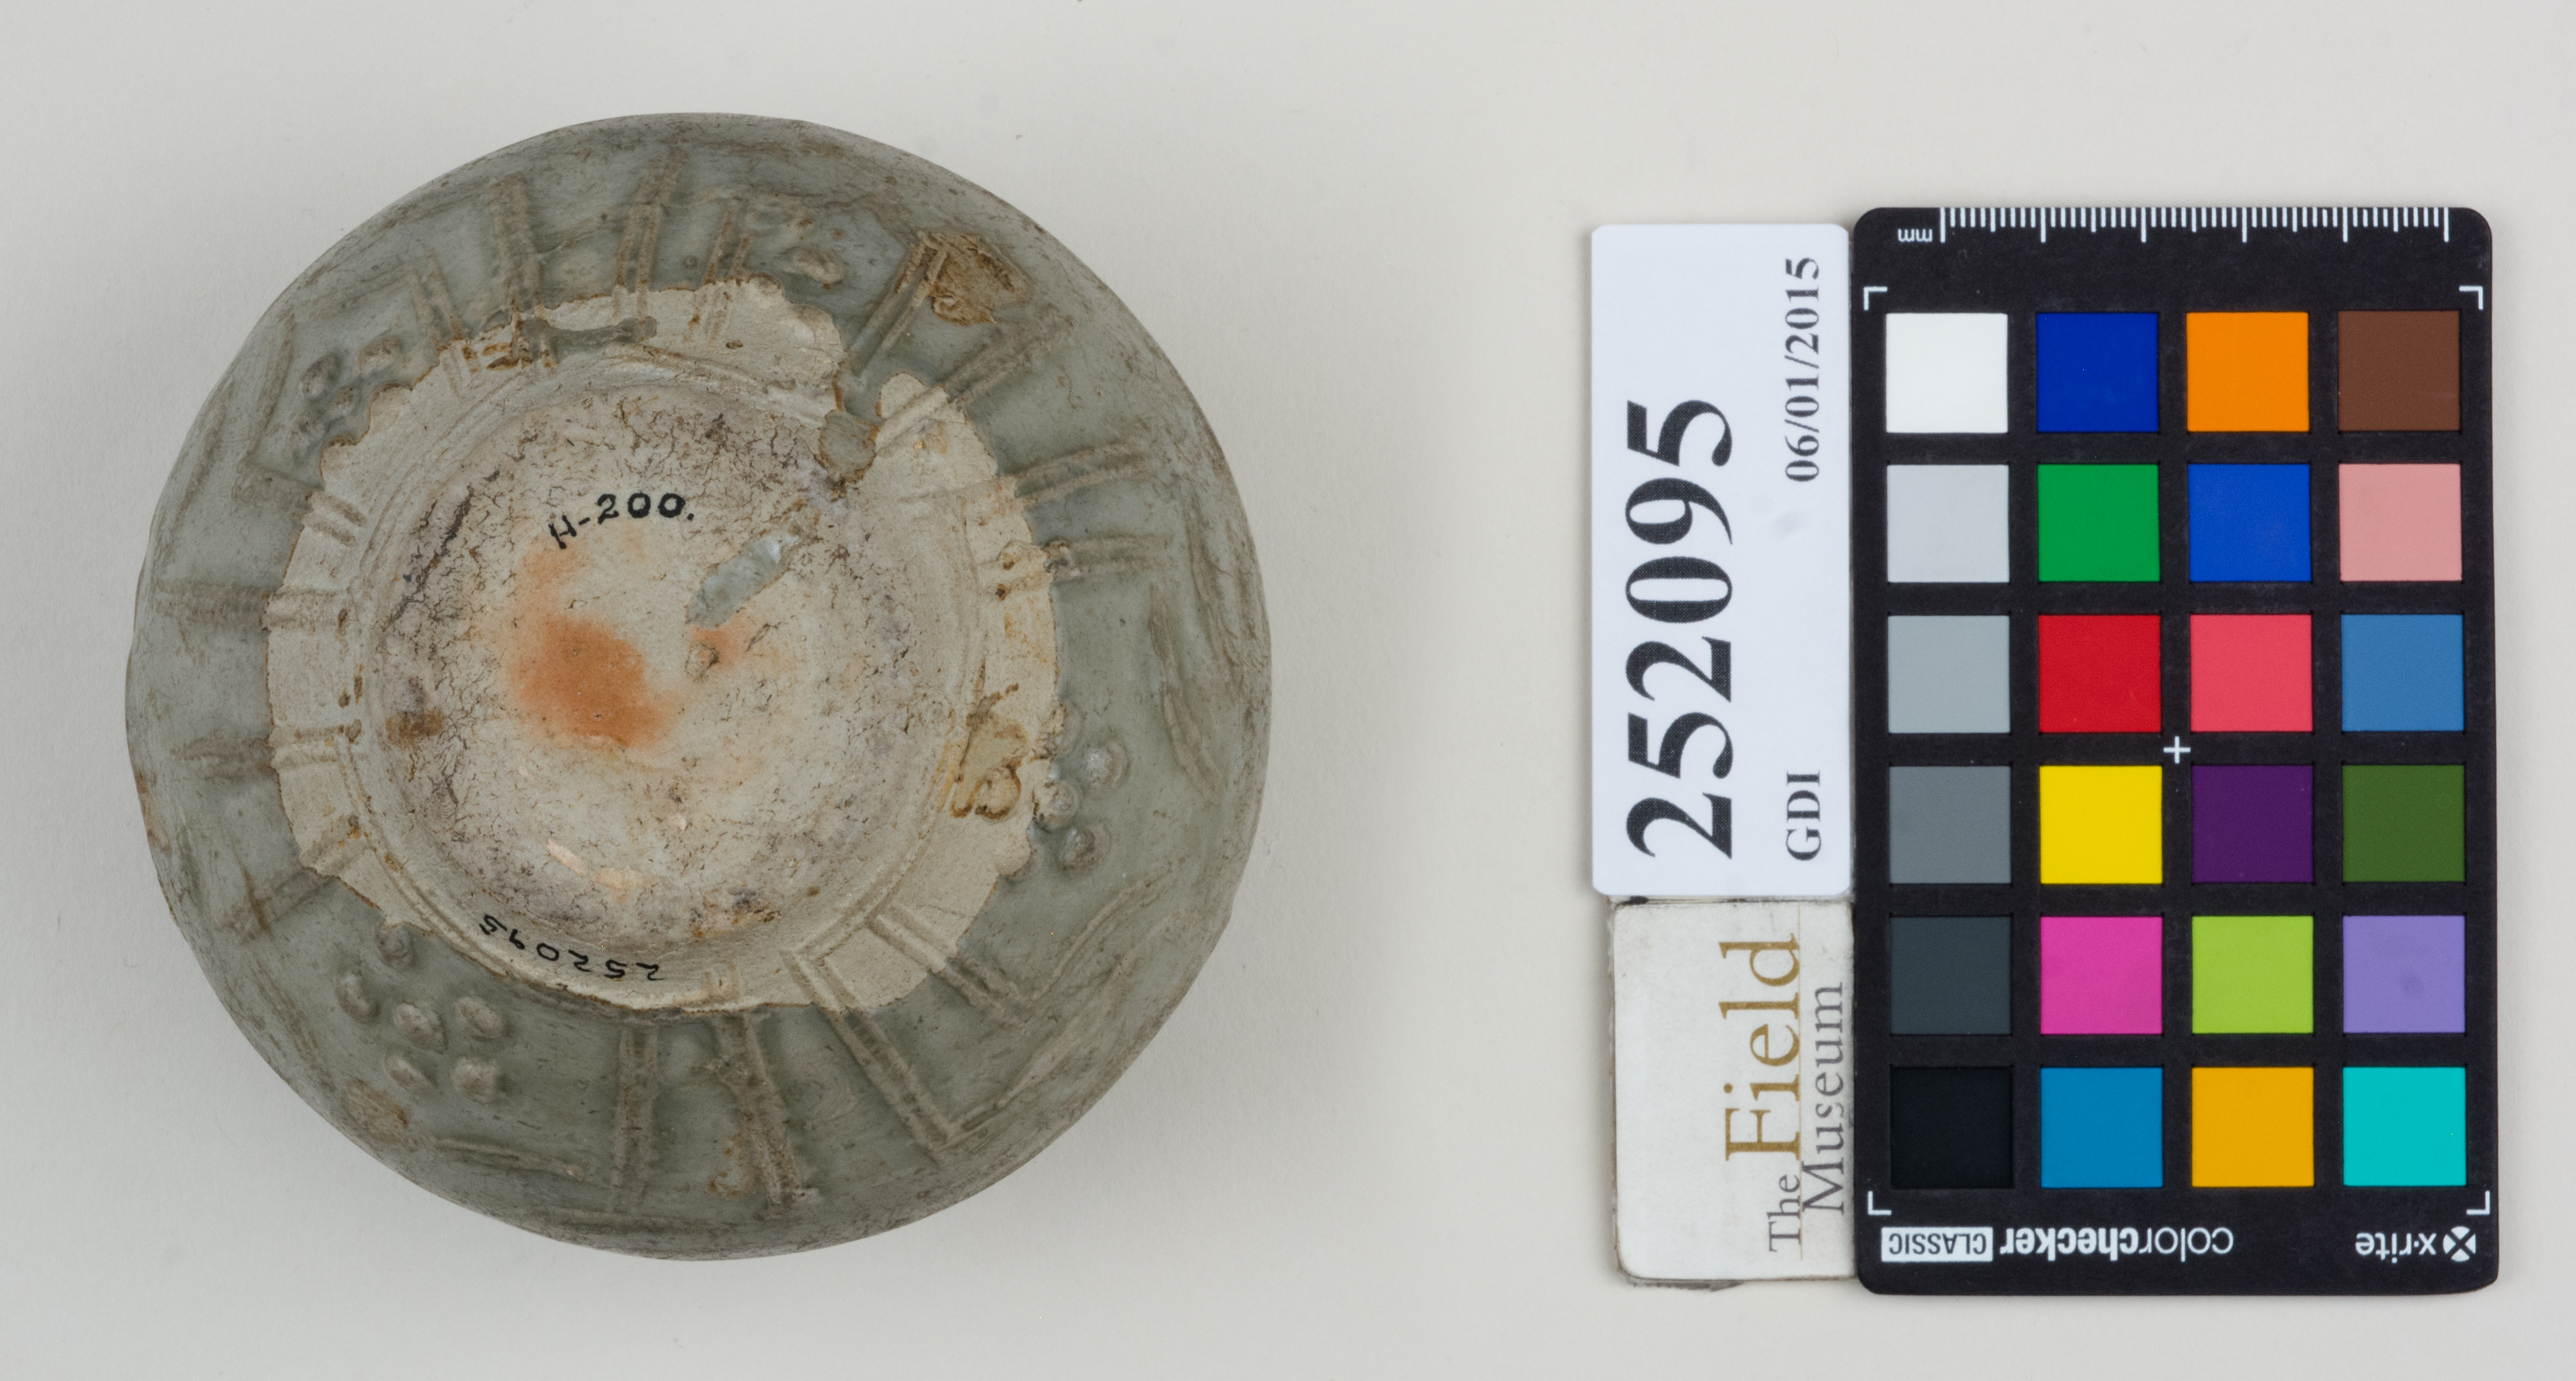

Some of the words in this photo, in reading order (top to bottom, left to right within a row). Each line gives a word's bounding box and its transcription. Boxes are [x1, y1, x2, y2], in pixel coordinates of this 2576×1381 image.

[1898, 228, 1933, 243] mm
[1785, 257, 1820, 483] 06/01/2015
[548, 493, 695, 550] H-200.
[1625, 400, 1734, 860] 252095
[1786, 771, 1822, 862] GDI
[479, 914, 668, 982] 252095
[1719, 932, 1801, 1161] Field
[1802, 981, 1844, 1215] Museum
[1768, 1173, 1802, 1253] The
[1888, 1233, 1987, 1256] CLASSIC
[2000, 1227, 2234, 1263] colorchecker
